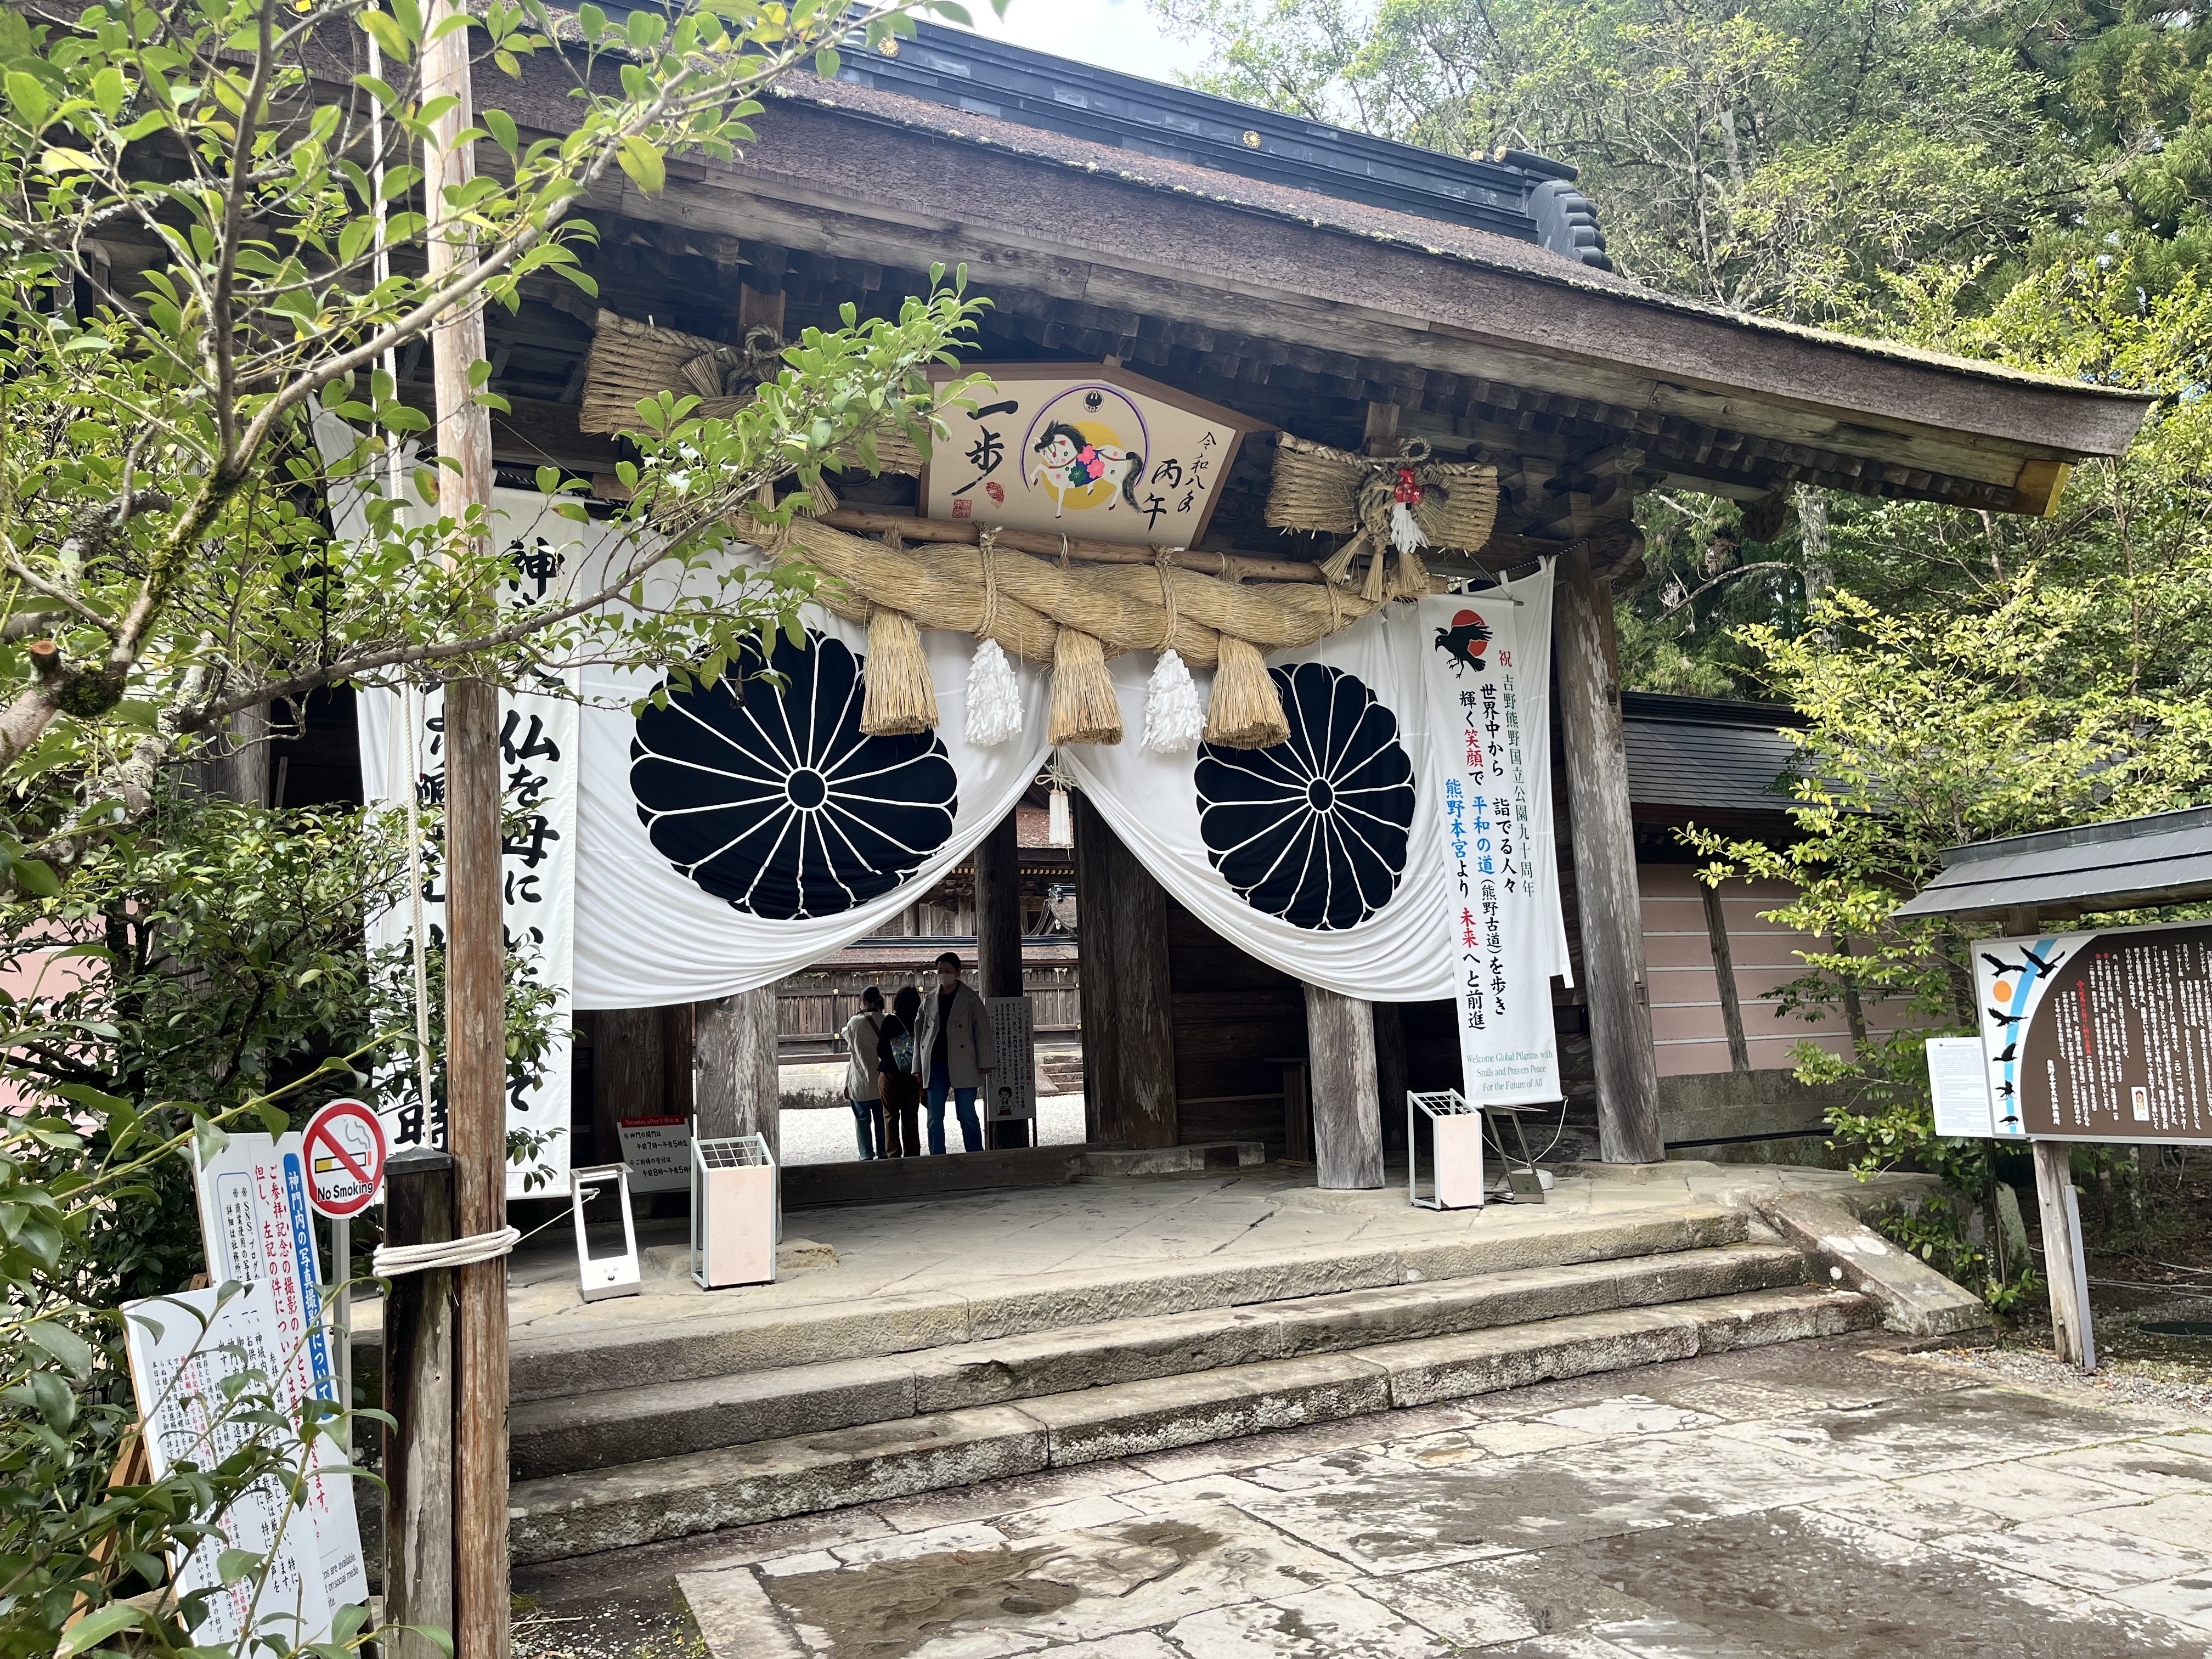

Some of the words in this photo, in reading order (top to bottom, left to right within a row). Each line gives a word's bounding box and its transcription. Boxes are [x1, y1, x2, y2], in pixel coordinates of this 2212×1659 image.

[951, 400, 1019, 496] 一歩
[1142, 458, 1183, 532] 丙午
[1498, 650, 1513, 668] 祝
[1459, 690, 1485, 786] 輝く笑顔で
[1480, 684, 1504, 777] 世界中から
[1492, 798, 1517, 894] 詣でる人々
[1500, 674, 1535, 898] 吉野熊野国立公園九十周年
[1445, 778, 1470, 899] 熊野本宮より
[1459, 907, 1487, 1030] 未来へと前進
[1466, 1055, 1495, 1063] Welcome
[1496, 1052, 1514, 1062] Global
[1516, 1051, 1539, 1061] Pilgrims
[1540, 1049, 1553, 1059] with
[1495, 1066, 1506, 1076] and
[1508, 1066, 1530, 1076] Prayers
[1530, 1065, 1546, 1074] Peace
[1483, 1082, 1493, 1092] For
[1494, 1081, 1504, 1091] the
[1505, 1080, 1526, 1090] Future
[1527, 1079, 1533, 1088] of
[1534, 1078, 1543, 1087] All
[255, 1165, 270, 1206] 但し、
[318, 1187, 331, 1201] No
[334, 1181, 373, 1199] Smoking
[329, 1582, 335, 1591] on
[335, 1571, 347, 1588] social
[347, 1564, 359, 1581] media
